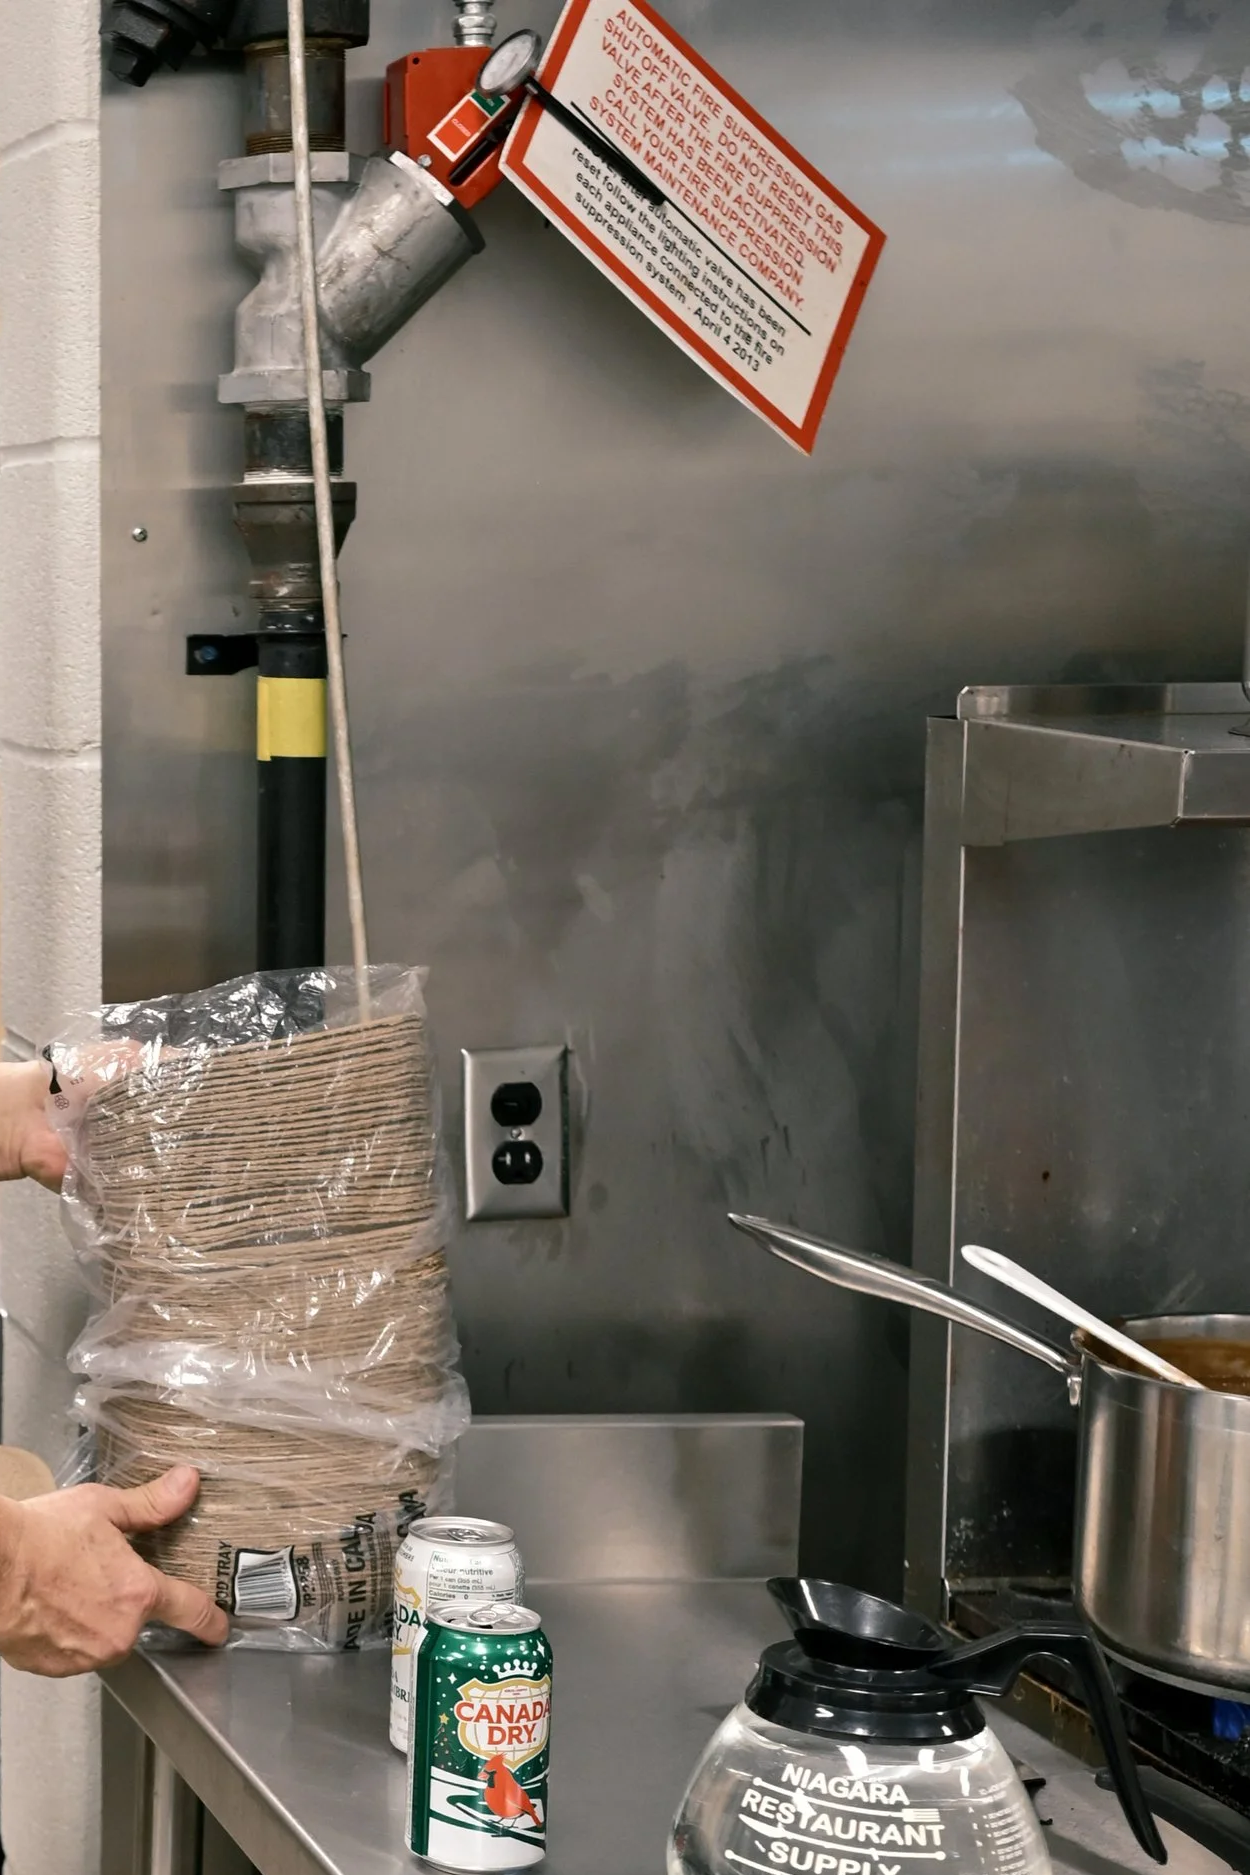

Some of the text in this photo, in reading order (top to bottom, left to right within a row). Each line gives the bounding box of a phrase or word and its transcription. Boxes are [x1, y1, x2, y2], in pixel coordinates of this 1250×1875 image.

[601, 36, 836, 273] VALVE AFTER THE FIRE SUPPRESSION
[604, 17, 843, 257] SHUT OFF VALVE. DO NOT RESET THIS
[604, 88, 637, 129] CALL
[642, 123, 678, 166] YOUR
[679, 162, 709, 198] FIRE
[711, 194, 803, 285] SUPPRESSION
[612, 73, 665, 130] SYSTEM
[666, 127, 694, 160] HAS
[696, 156, 732, 196] BEEN
[616, 9, 843, 235] AUTOMATIC FIRE SUPPRESSION GAS
[571, 147, 601, 180] reset
[601, 175, 637, 213] follow
[637, 210, 656, 234] the
[657, 230, 700, 278] lighting
[701, 272, 767, 340] instructions
[769, 338, 785, 356] on
[589, 95, 642, 153] SYSTEM
[643, 150, 737, 247] MAINTENANCE
[738, 243, 804, 310] COMPANY.
[574, 191, 643, 263] suppression
[645, 261, 686, 304] system
[692, 306, 722, 337] April
[722, 334, 731, 345] 4
[731, 341, 760, 372] 2013
[575, 172, 603, 202] each
[604, 200, 658, 256] appliance
[659, 255, 718, 313] connected
[719, 309, 731, 326] to
[753, 340, 773, 365] fire
[647, 200, 702, 258] automatic
[705, 256, 733, 288] valve
[735, 283, 756, 309] has
[757, 305, 786, 337] been
[215, 1541, 232, 1606] OOD TRAY
[343, 1609, 366, 1650] ADE
[348, 1580, 367, 1603] IN
[429, 1590, 456, 1599] Calories
[455, 1700, 551, 1724] CANADA
[487, 1723, 536, 1745] DRY
[741, 1788, 945, 1846] RESTAURANT
[781, 1763, 910, 1806] NIAGARA
